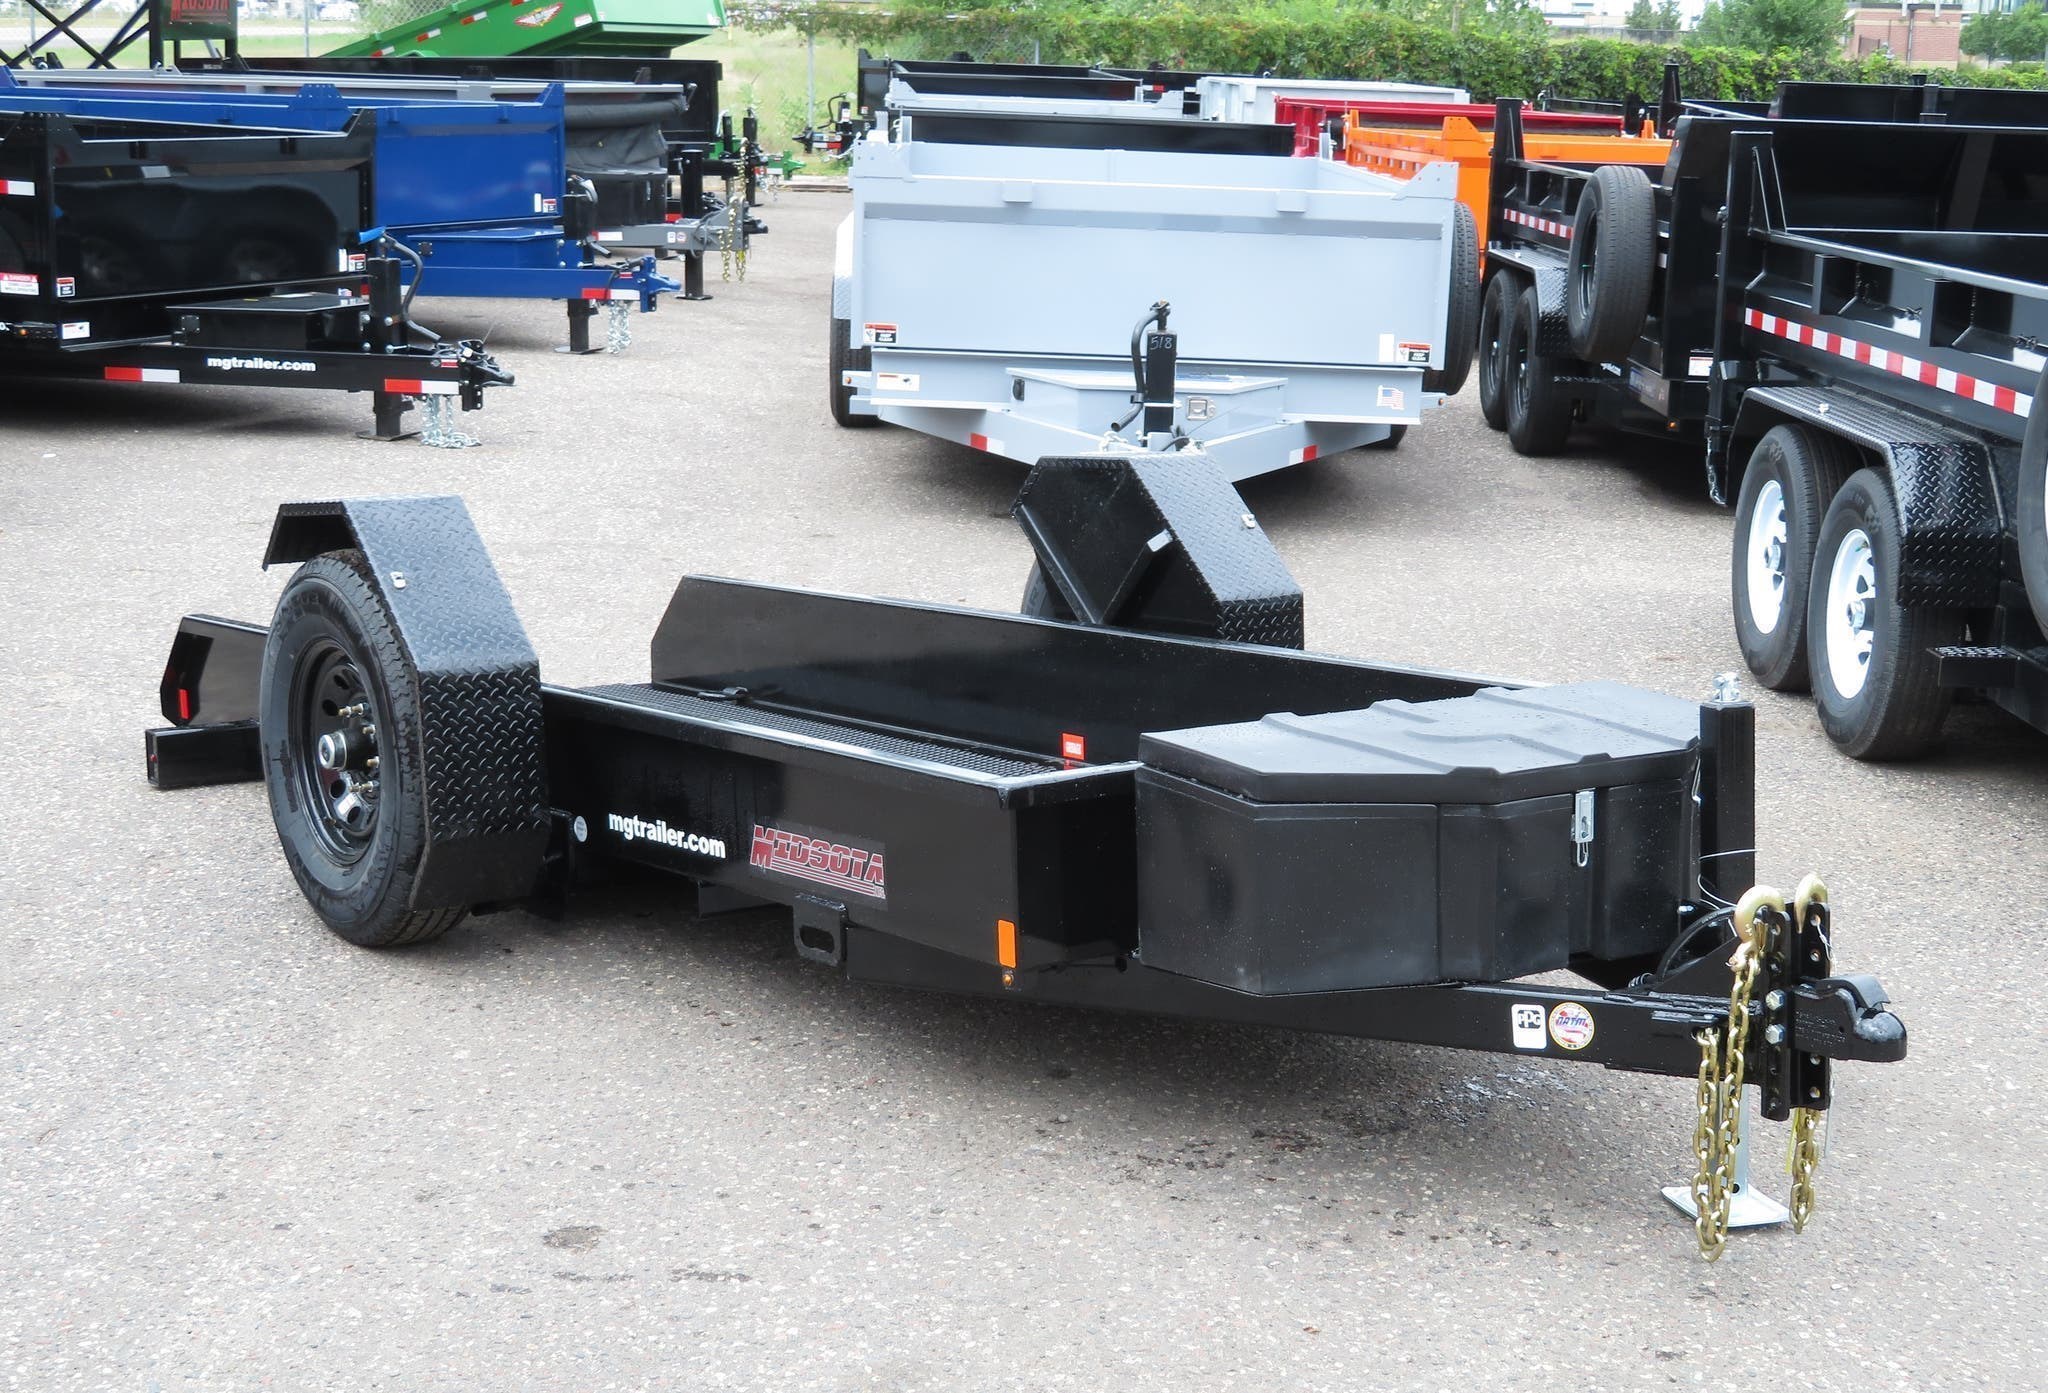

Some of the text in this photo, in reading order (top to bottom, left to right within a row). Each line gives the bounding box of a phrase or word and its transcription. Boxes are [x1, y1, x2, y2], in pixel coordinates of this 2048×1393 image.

[1151, 336, 1173, 350] 518
[207, 357, 316, 371] mgtrailer.com
[608, 812, 726, 858] mgtrailer.com
[750, 824, 885, 886] MIDSOTA
[1518, 1009, 1541, 1028] PPG
